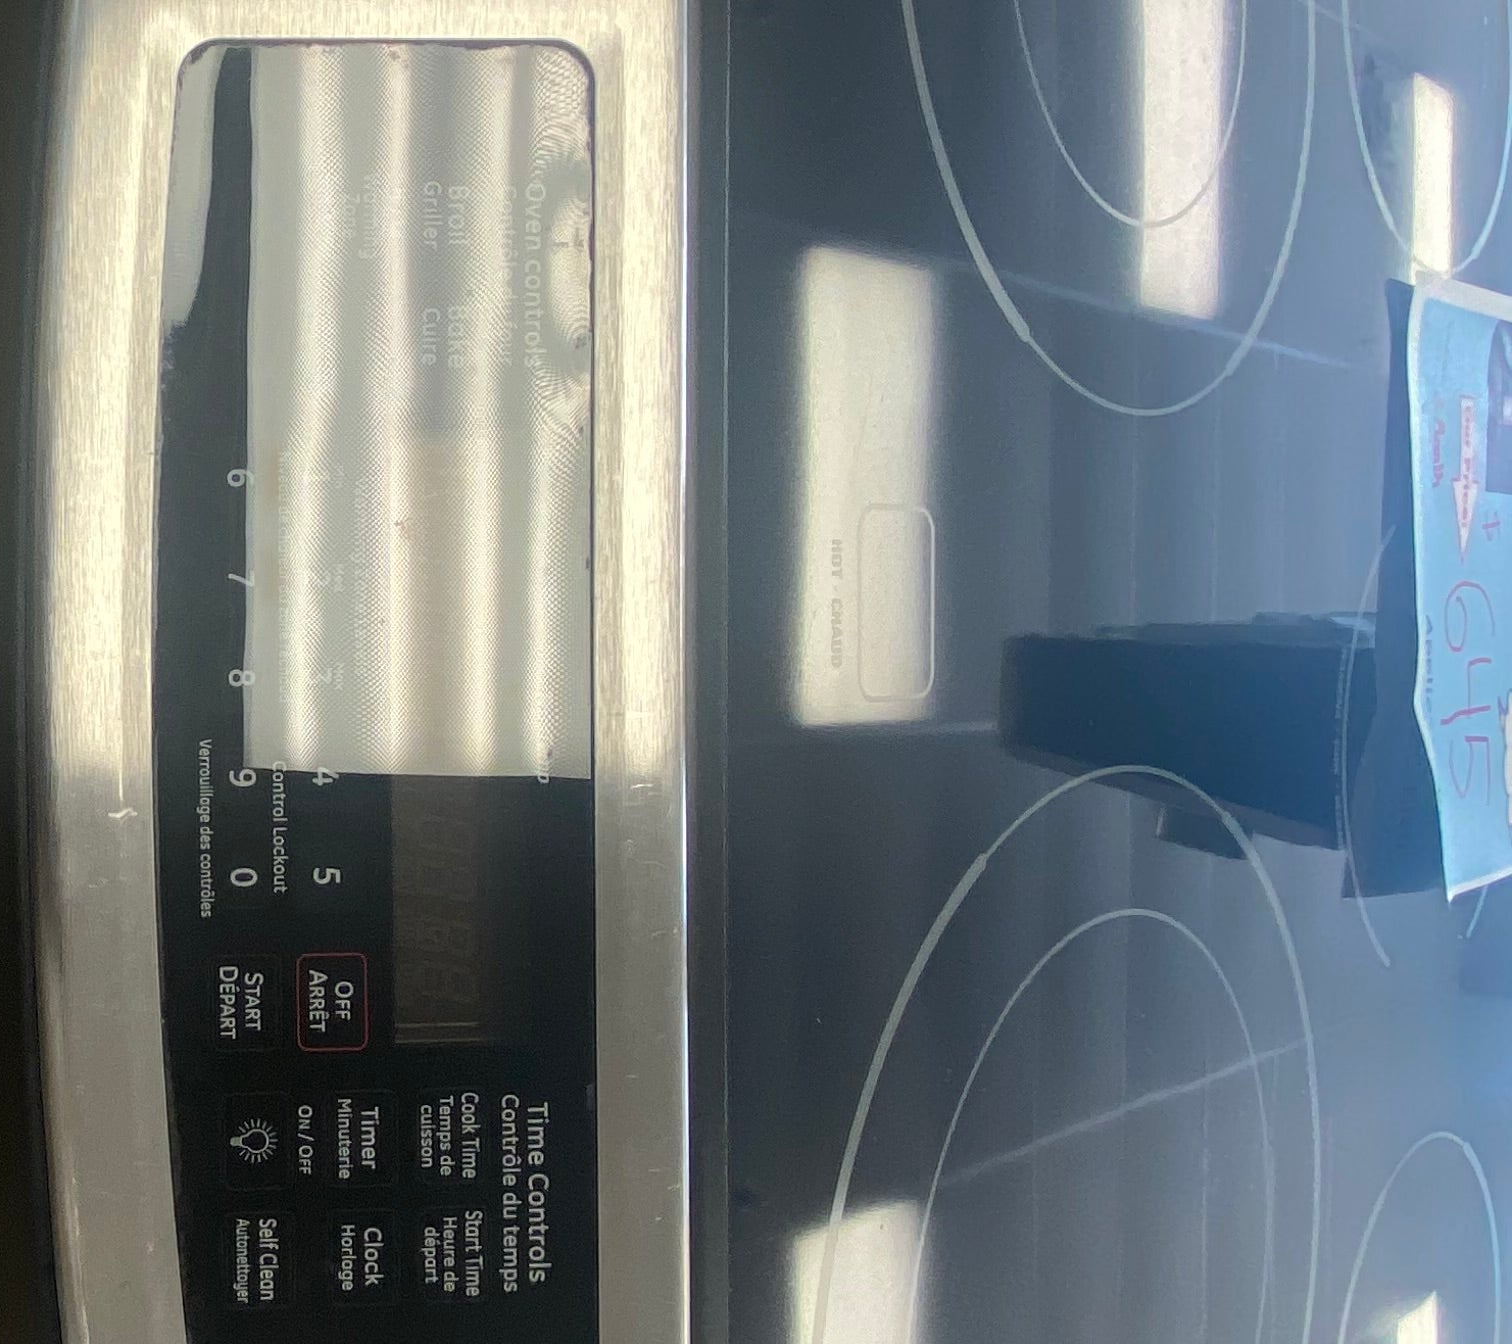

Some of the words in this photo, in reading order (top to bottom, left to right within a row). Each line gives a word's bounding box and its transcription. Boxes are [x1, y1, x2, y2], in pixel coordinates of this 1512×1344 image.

[422, 180, 443, 251] Griller
[446, 185, 470, 247] Broil
[524, 182, 548, 251] Oven
[421, 307, 442, 367] Cuire
[446, 304, 470, 370] Bake
[226, 468, 255, 488] 6
[227, 570, 255, 588] 7
[830, 538, 843, 580] HOT
[829, 598, 843, 670] CHAUD
[228, 668, 256, 687] 8
[1439, 580, 1497, 808] 645
[196, 738, 214, 823] Verrouillage
[228, 768, 257, 788] 9
[271, 760, 289, 823] Control
[312, 766, 339, 787] 4
[199, 825, 214, 850] des
[272, 826, 289, 894] Lockout
[199, 852, 216, 919] contrôles
[229, 867, 258, 888] 0
[312, 867, 341, 885] 5
[336, 1097, 354, 1181] Minuterie
[359, 1105, 381, 1170] Timer
[419, 1104, 438, 1168] cuisson
[435, 1094, 455, 1150] Temps
[460, 1092, 482, 1134] Cook
[500, 1094, 523, 1187] Contrôle
[526, 1101, 550, 1166] Time
[438, 1154, 456, 1177] de
[461, 1137, 481, 1179] Time
[257, 1217, 280, 1251] Self
[464, 1209, 484, 1253] Start
[502, 1192, 523, 1219] du
[527, 1172, 552, 1284] Controls
[232, 1218, 251, 1305] Autonettoyer
[363, 1227, 385, 1287] Clock
[419, 1225, 441, 1285] départ
[442, 1216, 458, 1268] Heure
[498, 1224, 521, 1293] temps
[258, 1253, 280, 1302] Clean
[442, 1270, 460, 1292] de
[464, 1254, 484, 1297] Time
